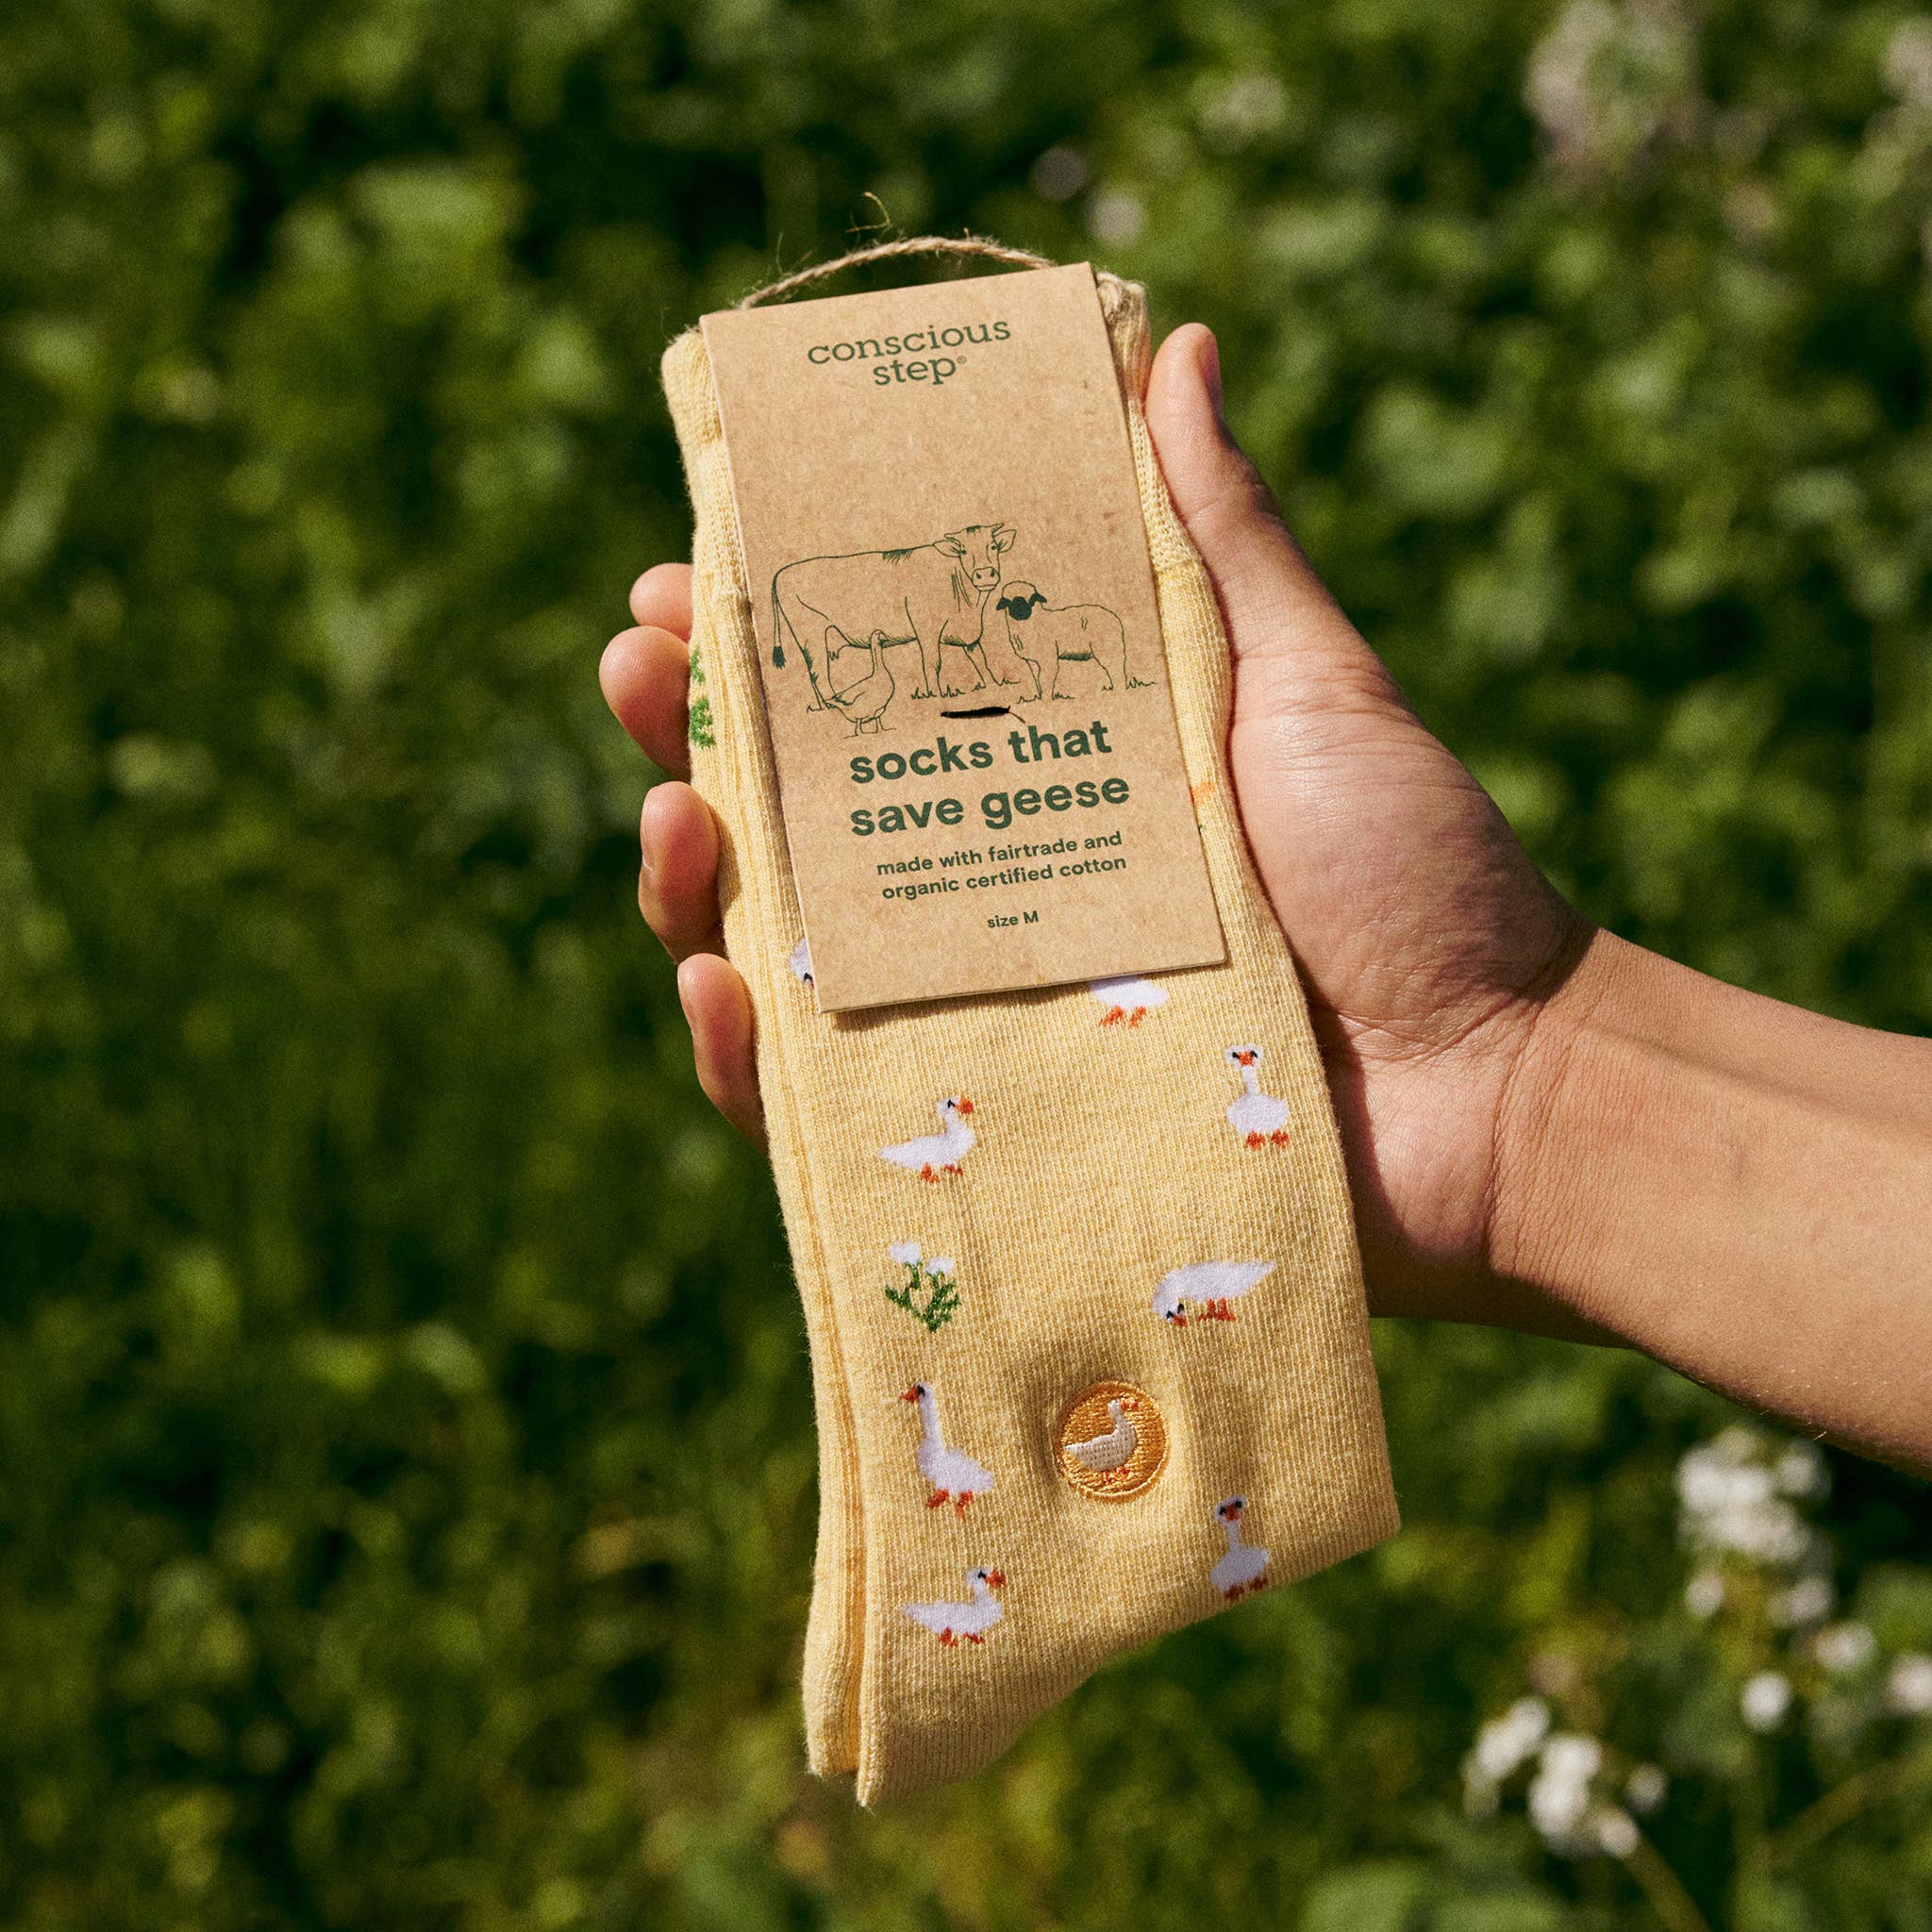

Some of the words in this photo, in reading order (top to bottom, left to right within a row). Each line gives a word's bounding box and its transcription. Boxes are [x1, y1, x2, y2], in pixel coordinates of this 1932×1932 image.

[808, 321, 1011, 365] conscious
[849, 736, 994, 784] socks
[1007, 720, 1113, 763] that
[850, 797, 964, 837] save
[980, 777, 1130, 829] geese
[876, 855, 934, 875] made
[939, 849, 983, 867] with
[989, 839, 1078, 862] fairtrade
[1084, 830, 1123, 849] and
[881, 875, 960, 900] organic
[965, 863, 1054, 891] certified
[1058, 855, 1127, 878] cotton
[987, 915, 1020, 928] size
[1024, 910, 1040, 924] M
